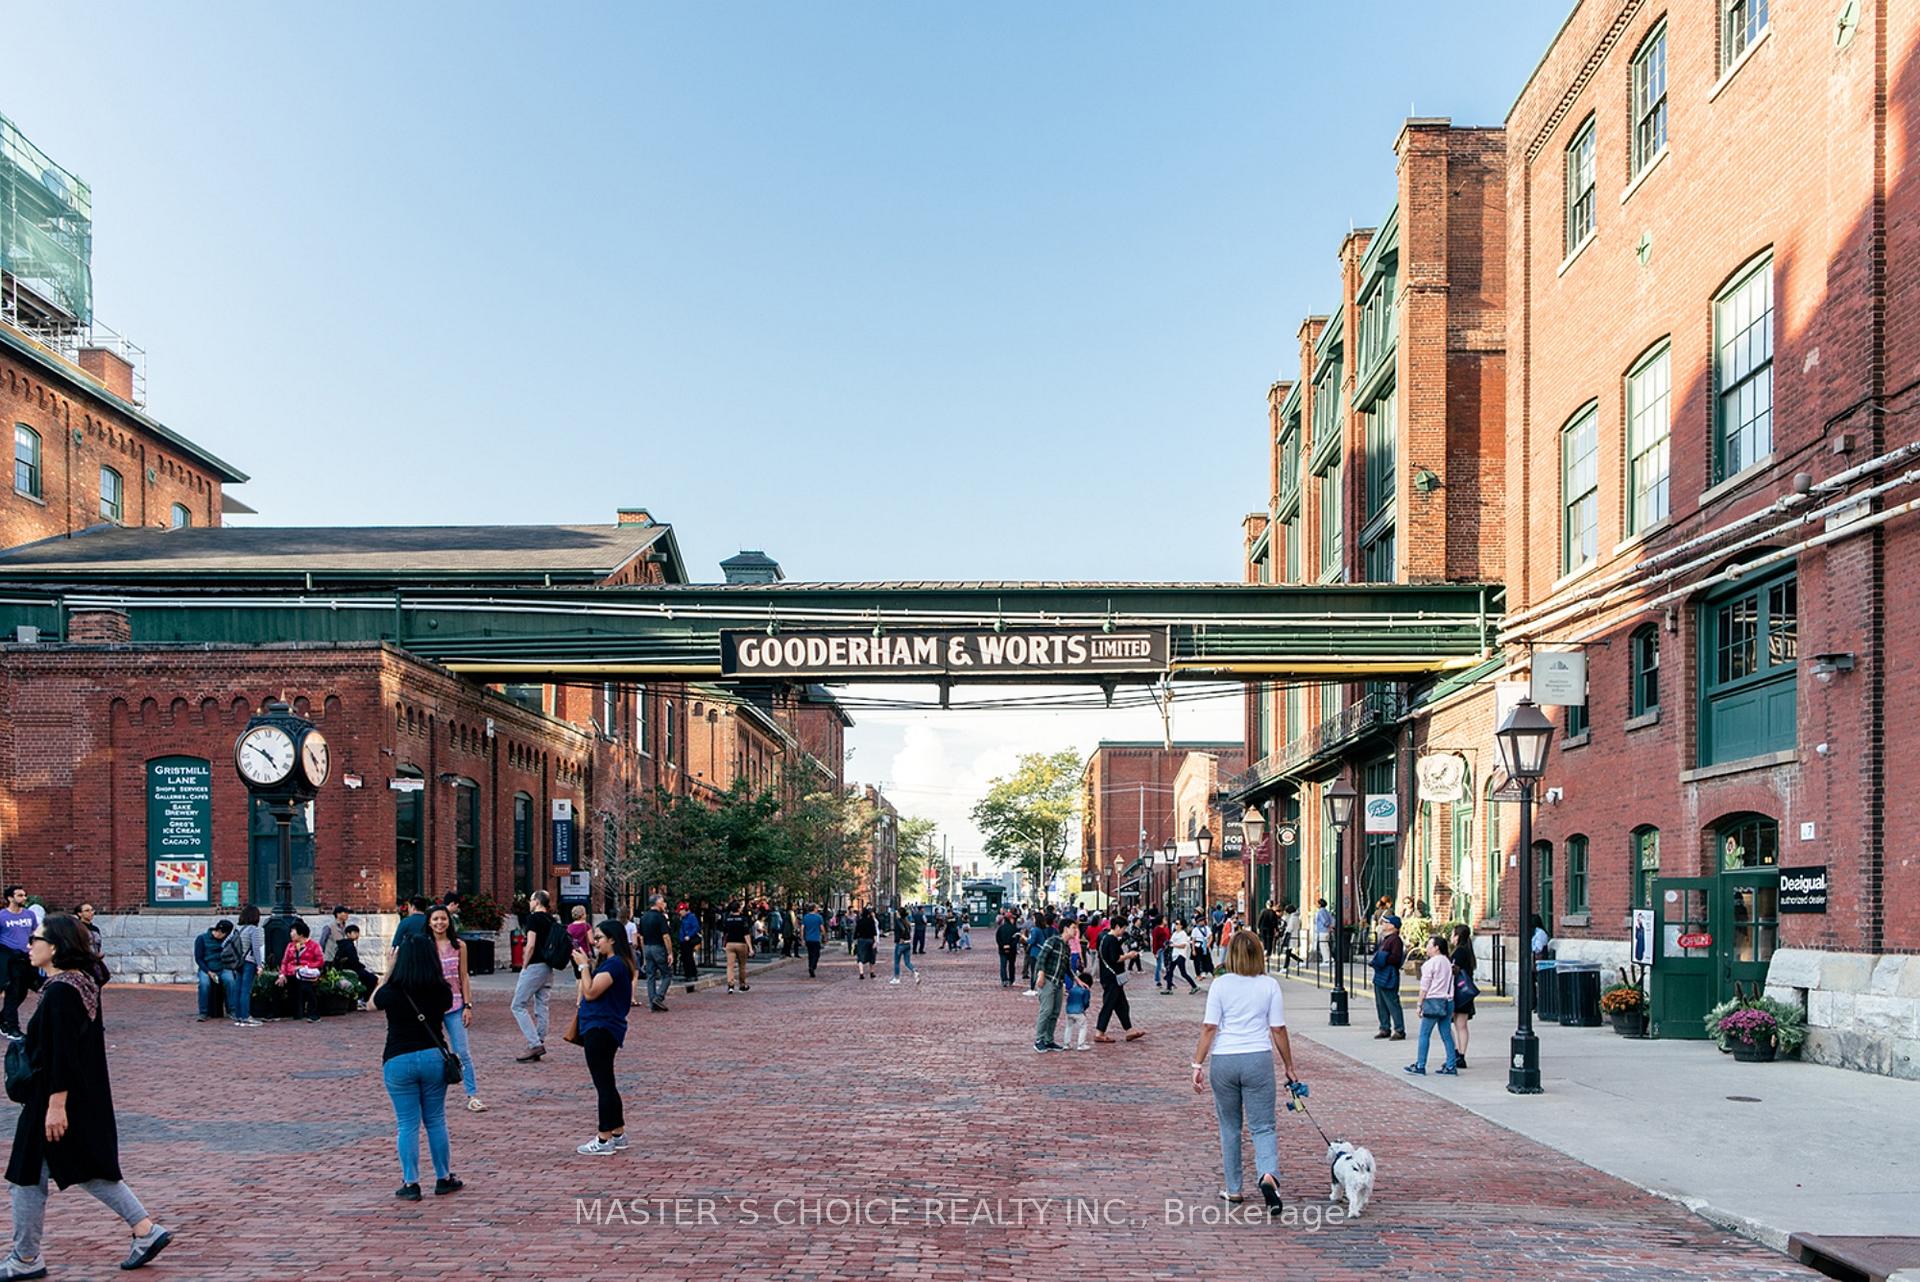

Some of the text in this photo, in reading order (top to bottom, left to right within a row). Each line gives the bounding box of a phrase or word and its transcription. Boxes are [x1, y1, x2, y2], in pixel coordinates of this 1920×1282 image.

[738, 634, 1151, 668] GOODERHAM & WORTS LIMITED
[154, 765, 209, 775] GRISTMILL
[167, 776, 197, 785] LANE
[1780, 895, 1827, 905] authorized dealer
